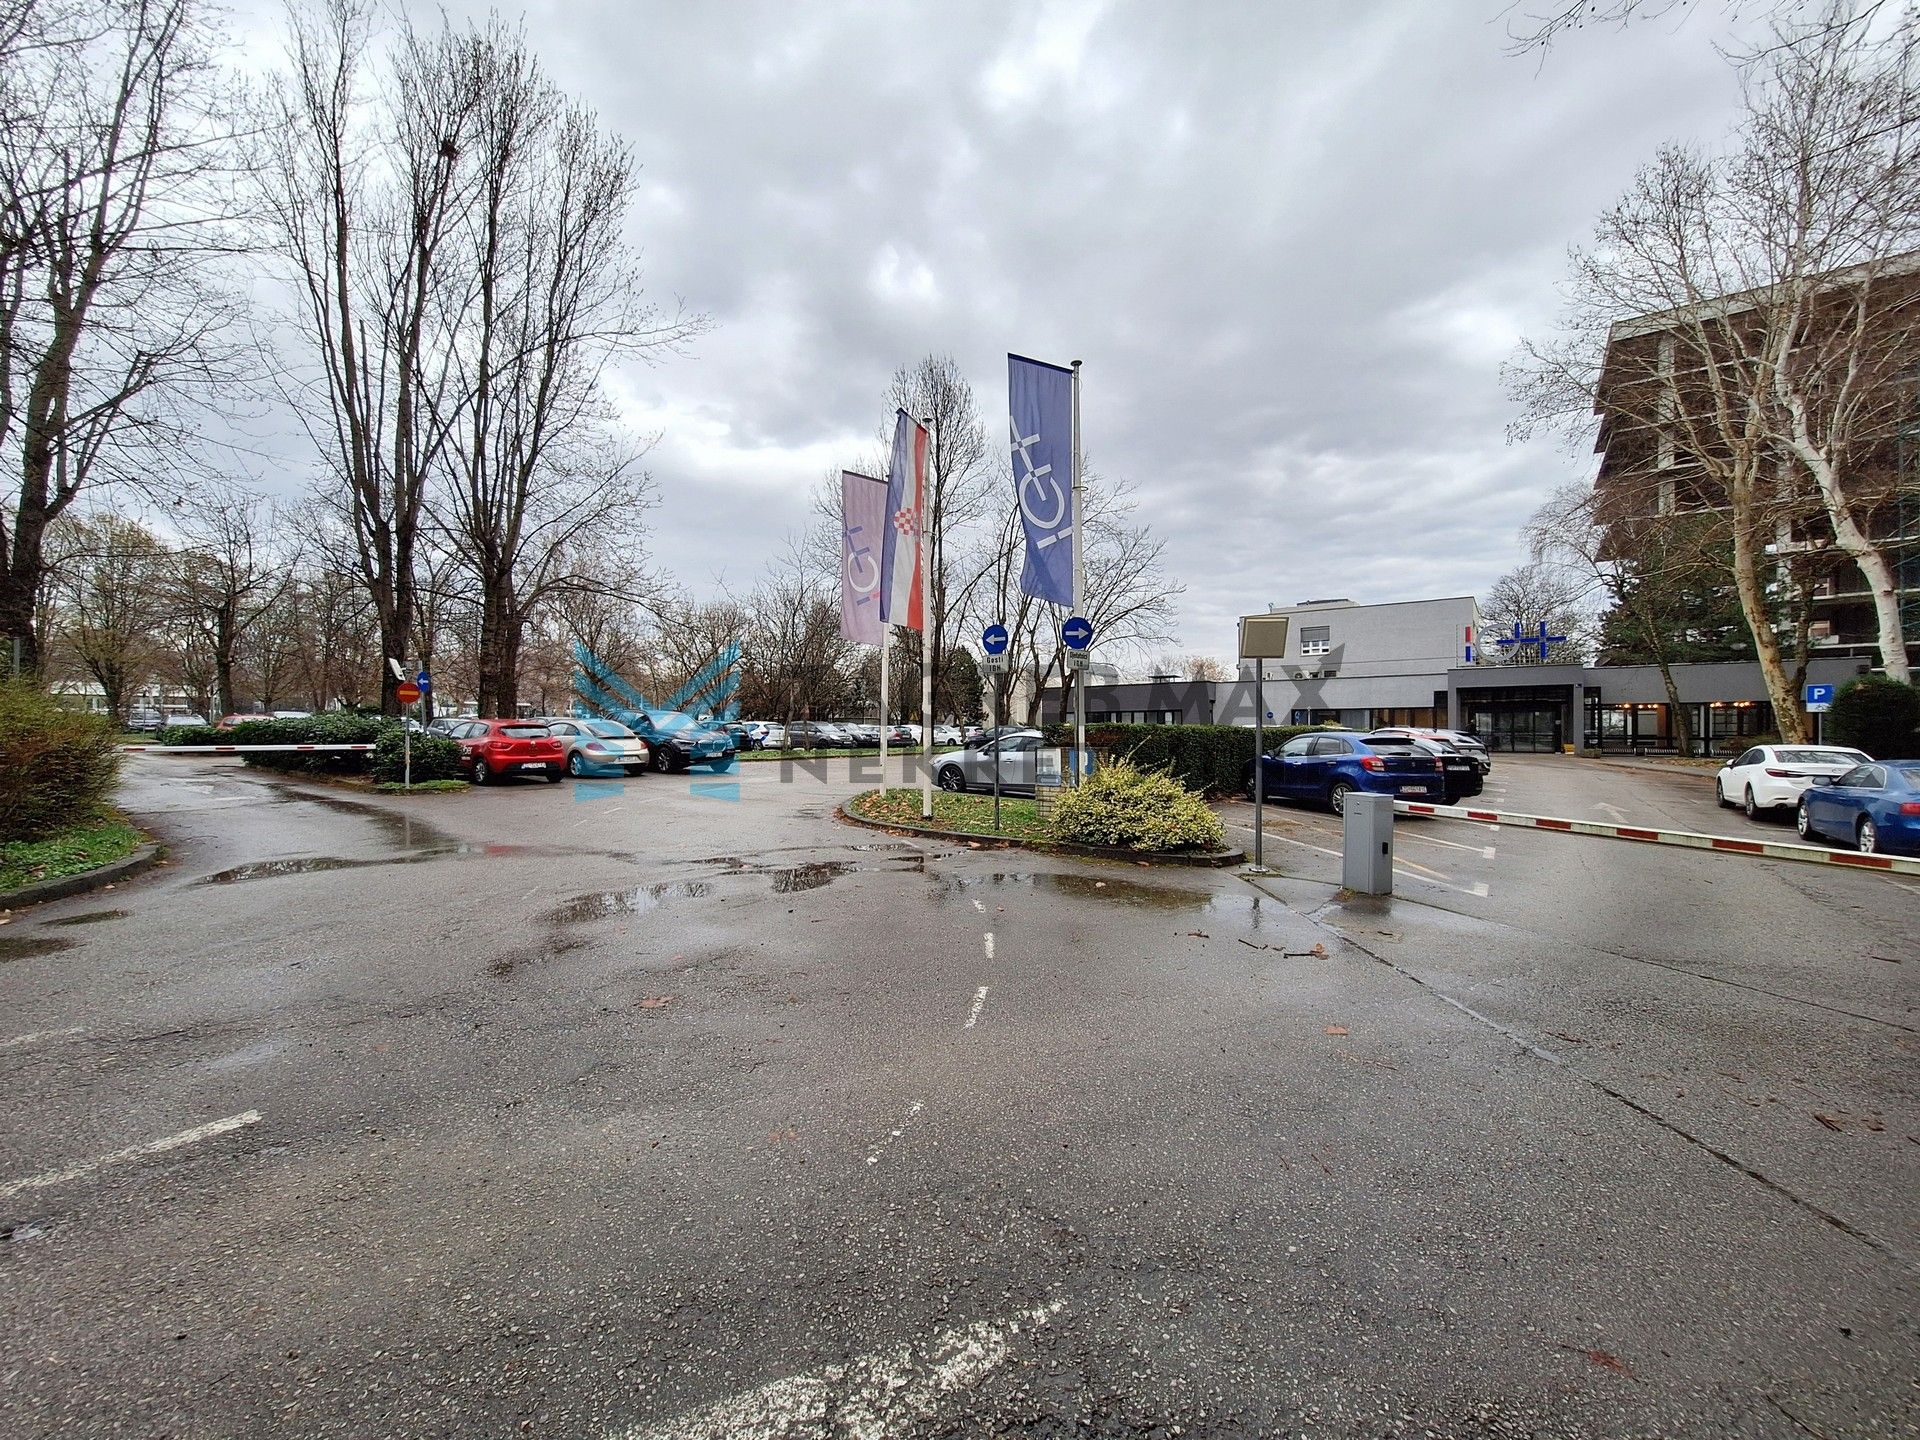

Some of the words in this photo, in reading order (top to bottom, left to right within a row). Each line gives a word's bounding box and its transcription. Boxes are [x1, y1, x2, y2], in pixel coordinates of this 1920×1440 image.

[986, 656, 1004, 664] Gosti
[989, 664, 1001, 672] IGH
[1813, 688, 1826, 700] P
